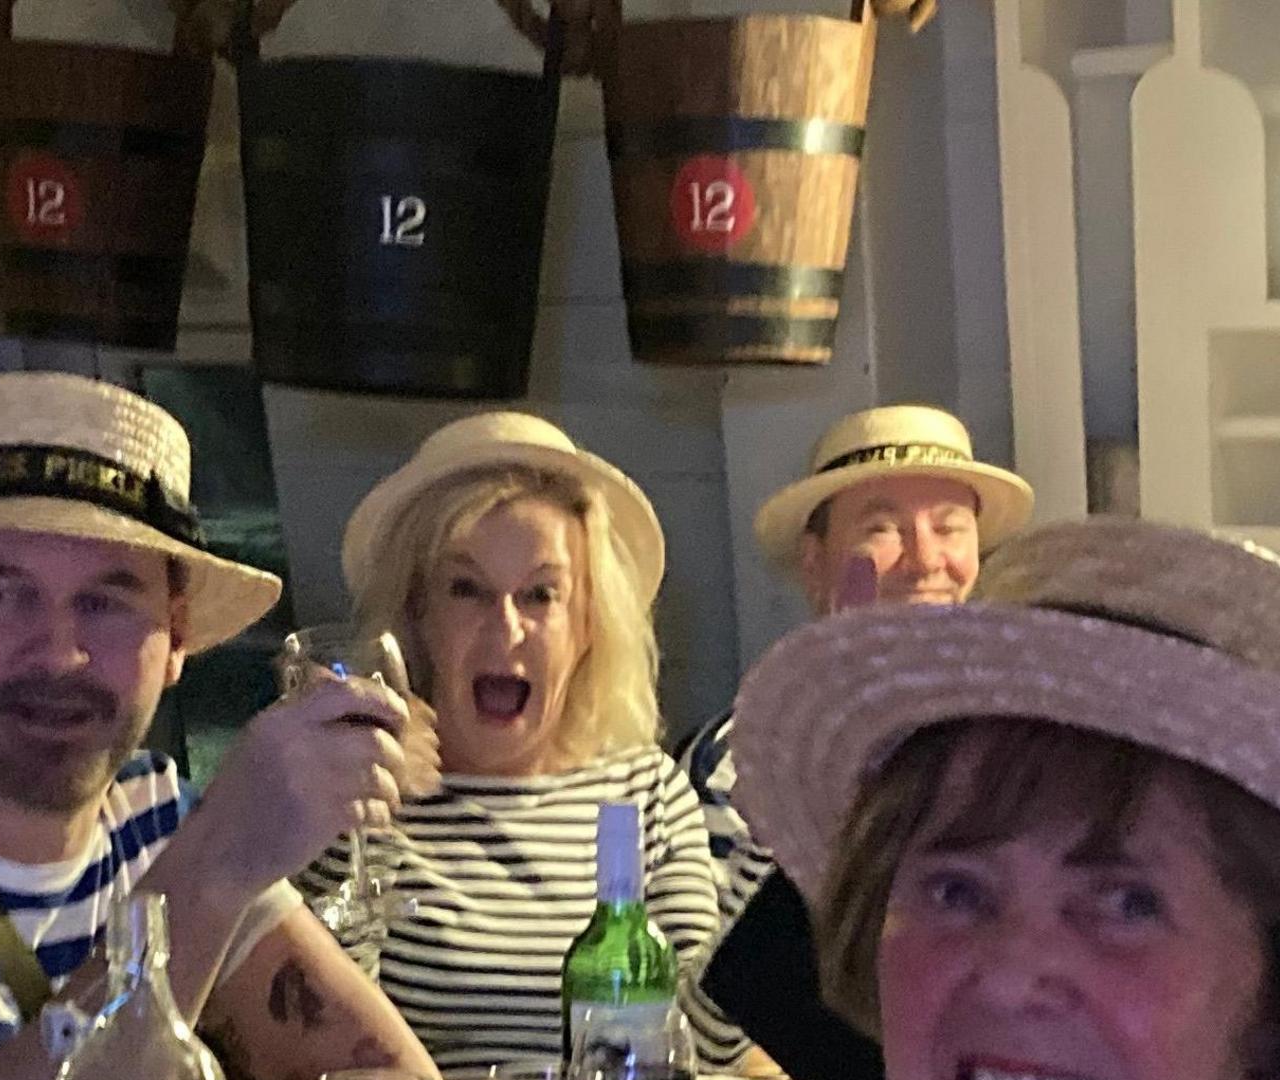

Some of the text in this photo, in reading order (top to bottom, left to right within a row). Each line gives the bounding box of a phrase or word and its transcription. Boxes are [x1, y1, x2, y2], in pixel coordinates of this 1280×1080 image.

[26, 177, 65, 225] 12
[379, 194, 426, 246] 12
[689, 180, 735, 233] 12
